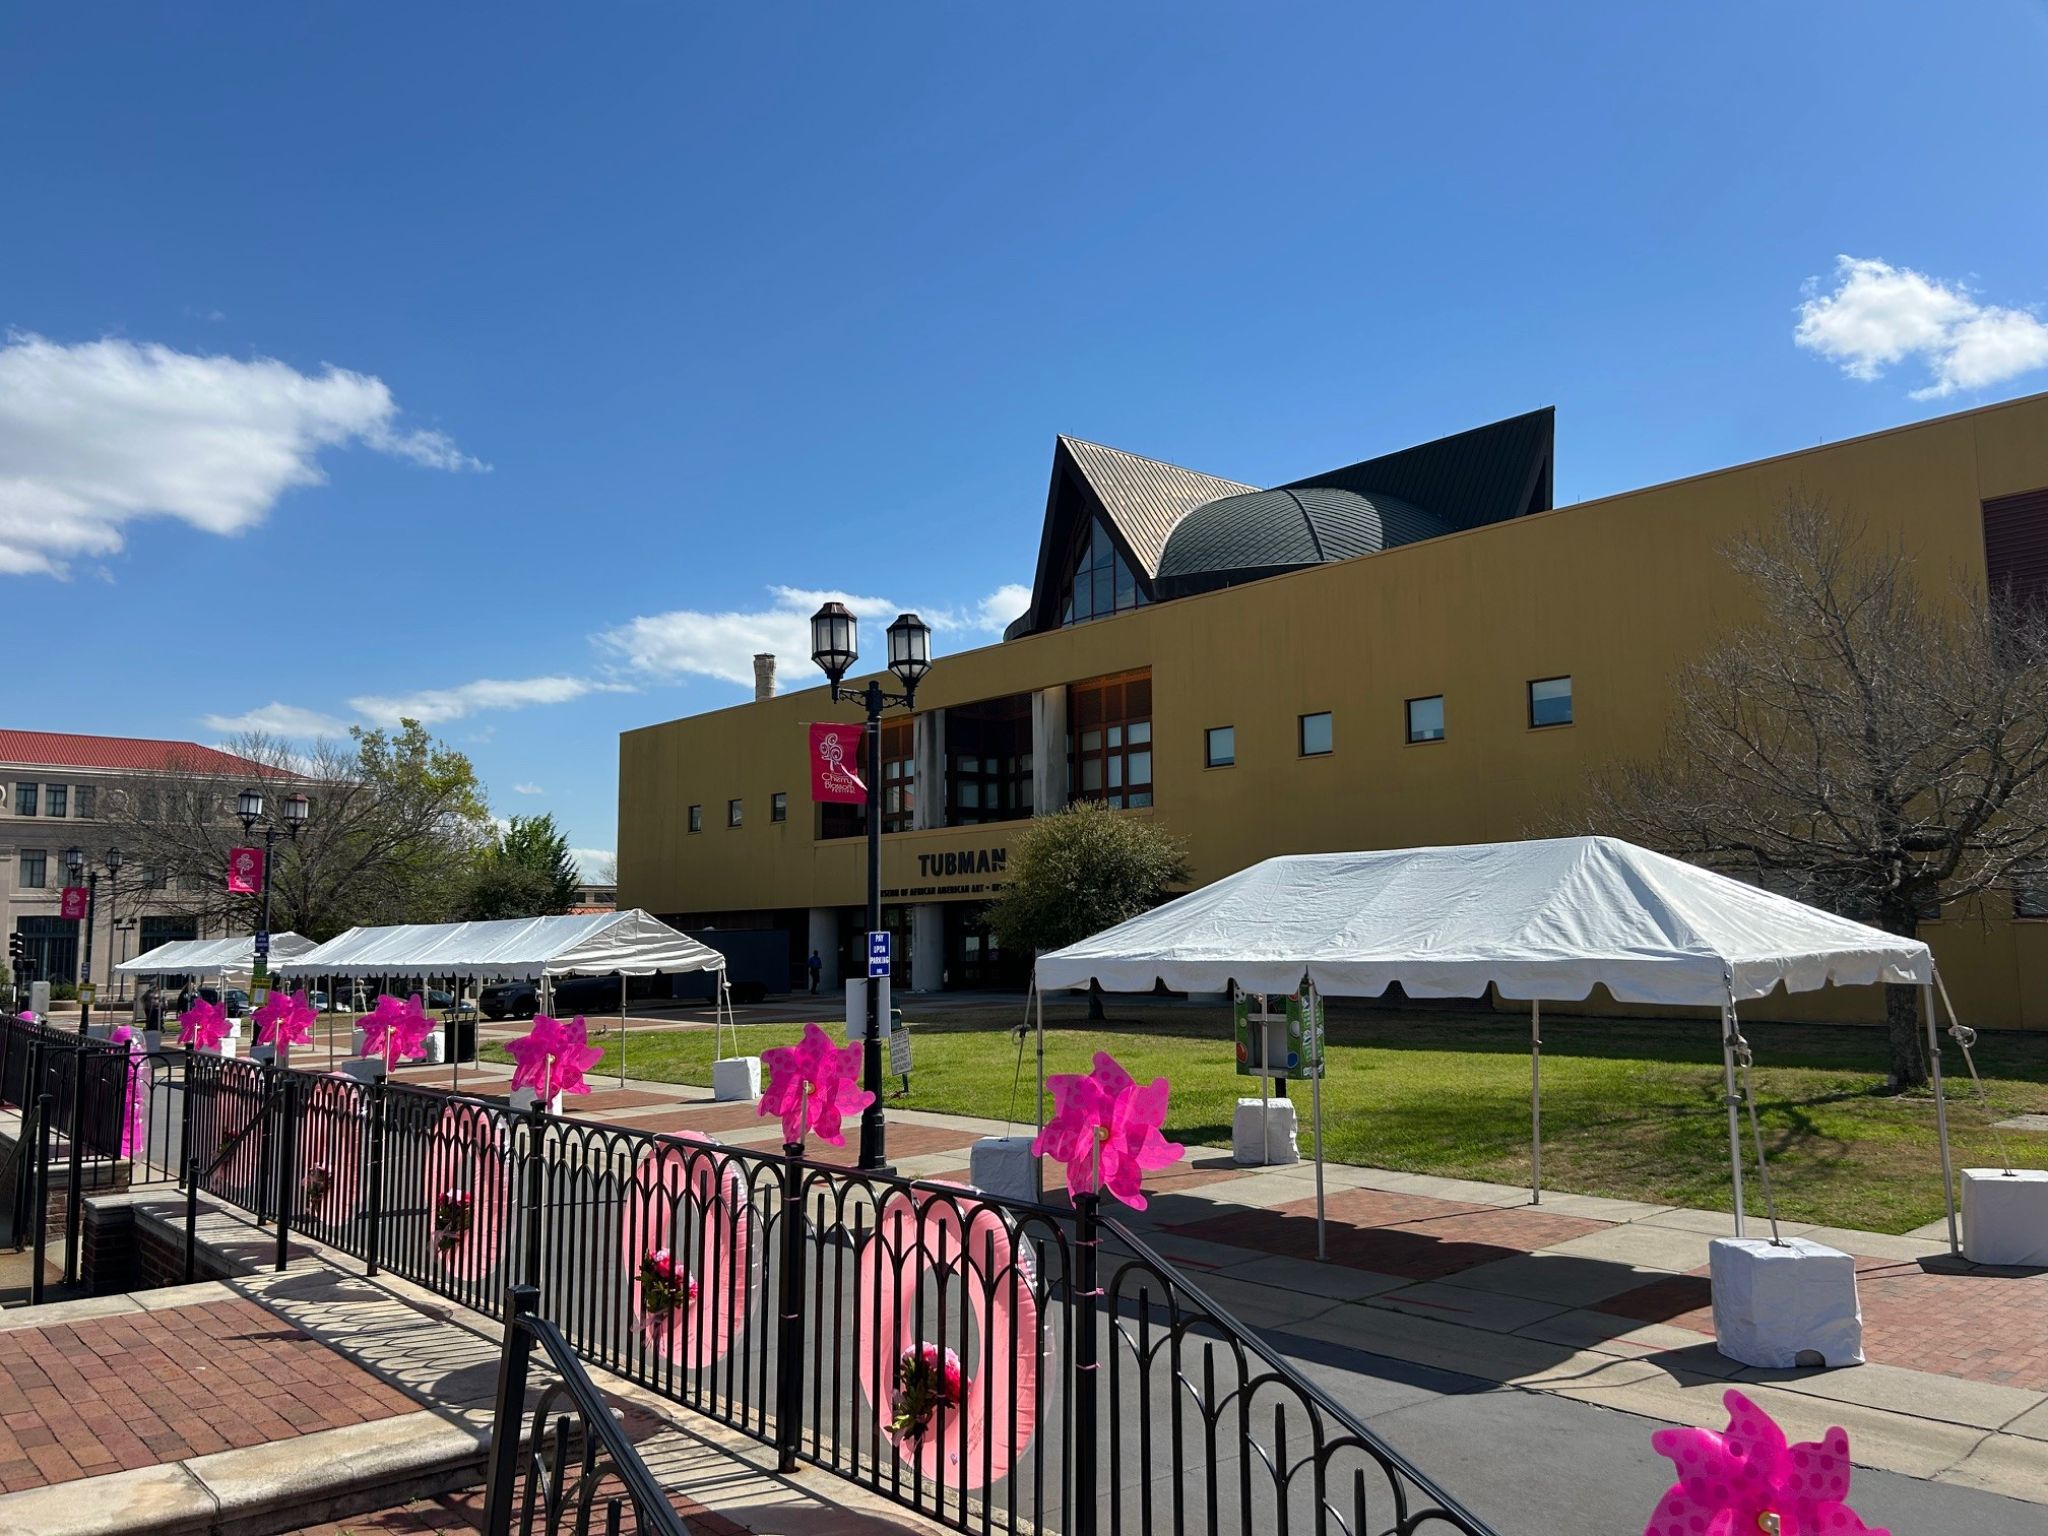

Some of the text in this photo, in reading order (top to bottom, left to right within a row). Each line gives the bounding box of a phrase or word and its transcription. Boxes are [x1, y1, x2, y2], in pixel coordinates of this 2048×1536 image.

[821, 772, 852, 784] Cherry
[918, 848, 1006, 876] TUBMAN
[910, 886, 936, 896] AFRICAN
[937, 885, 970, 894] AMERICAN
[971, 884, 984, 893] ART
[873, 945, 886, 953] UPON
[869, 956, 890, 964] PARKING
